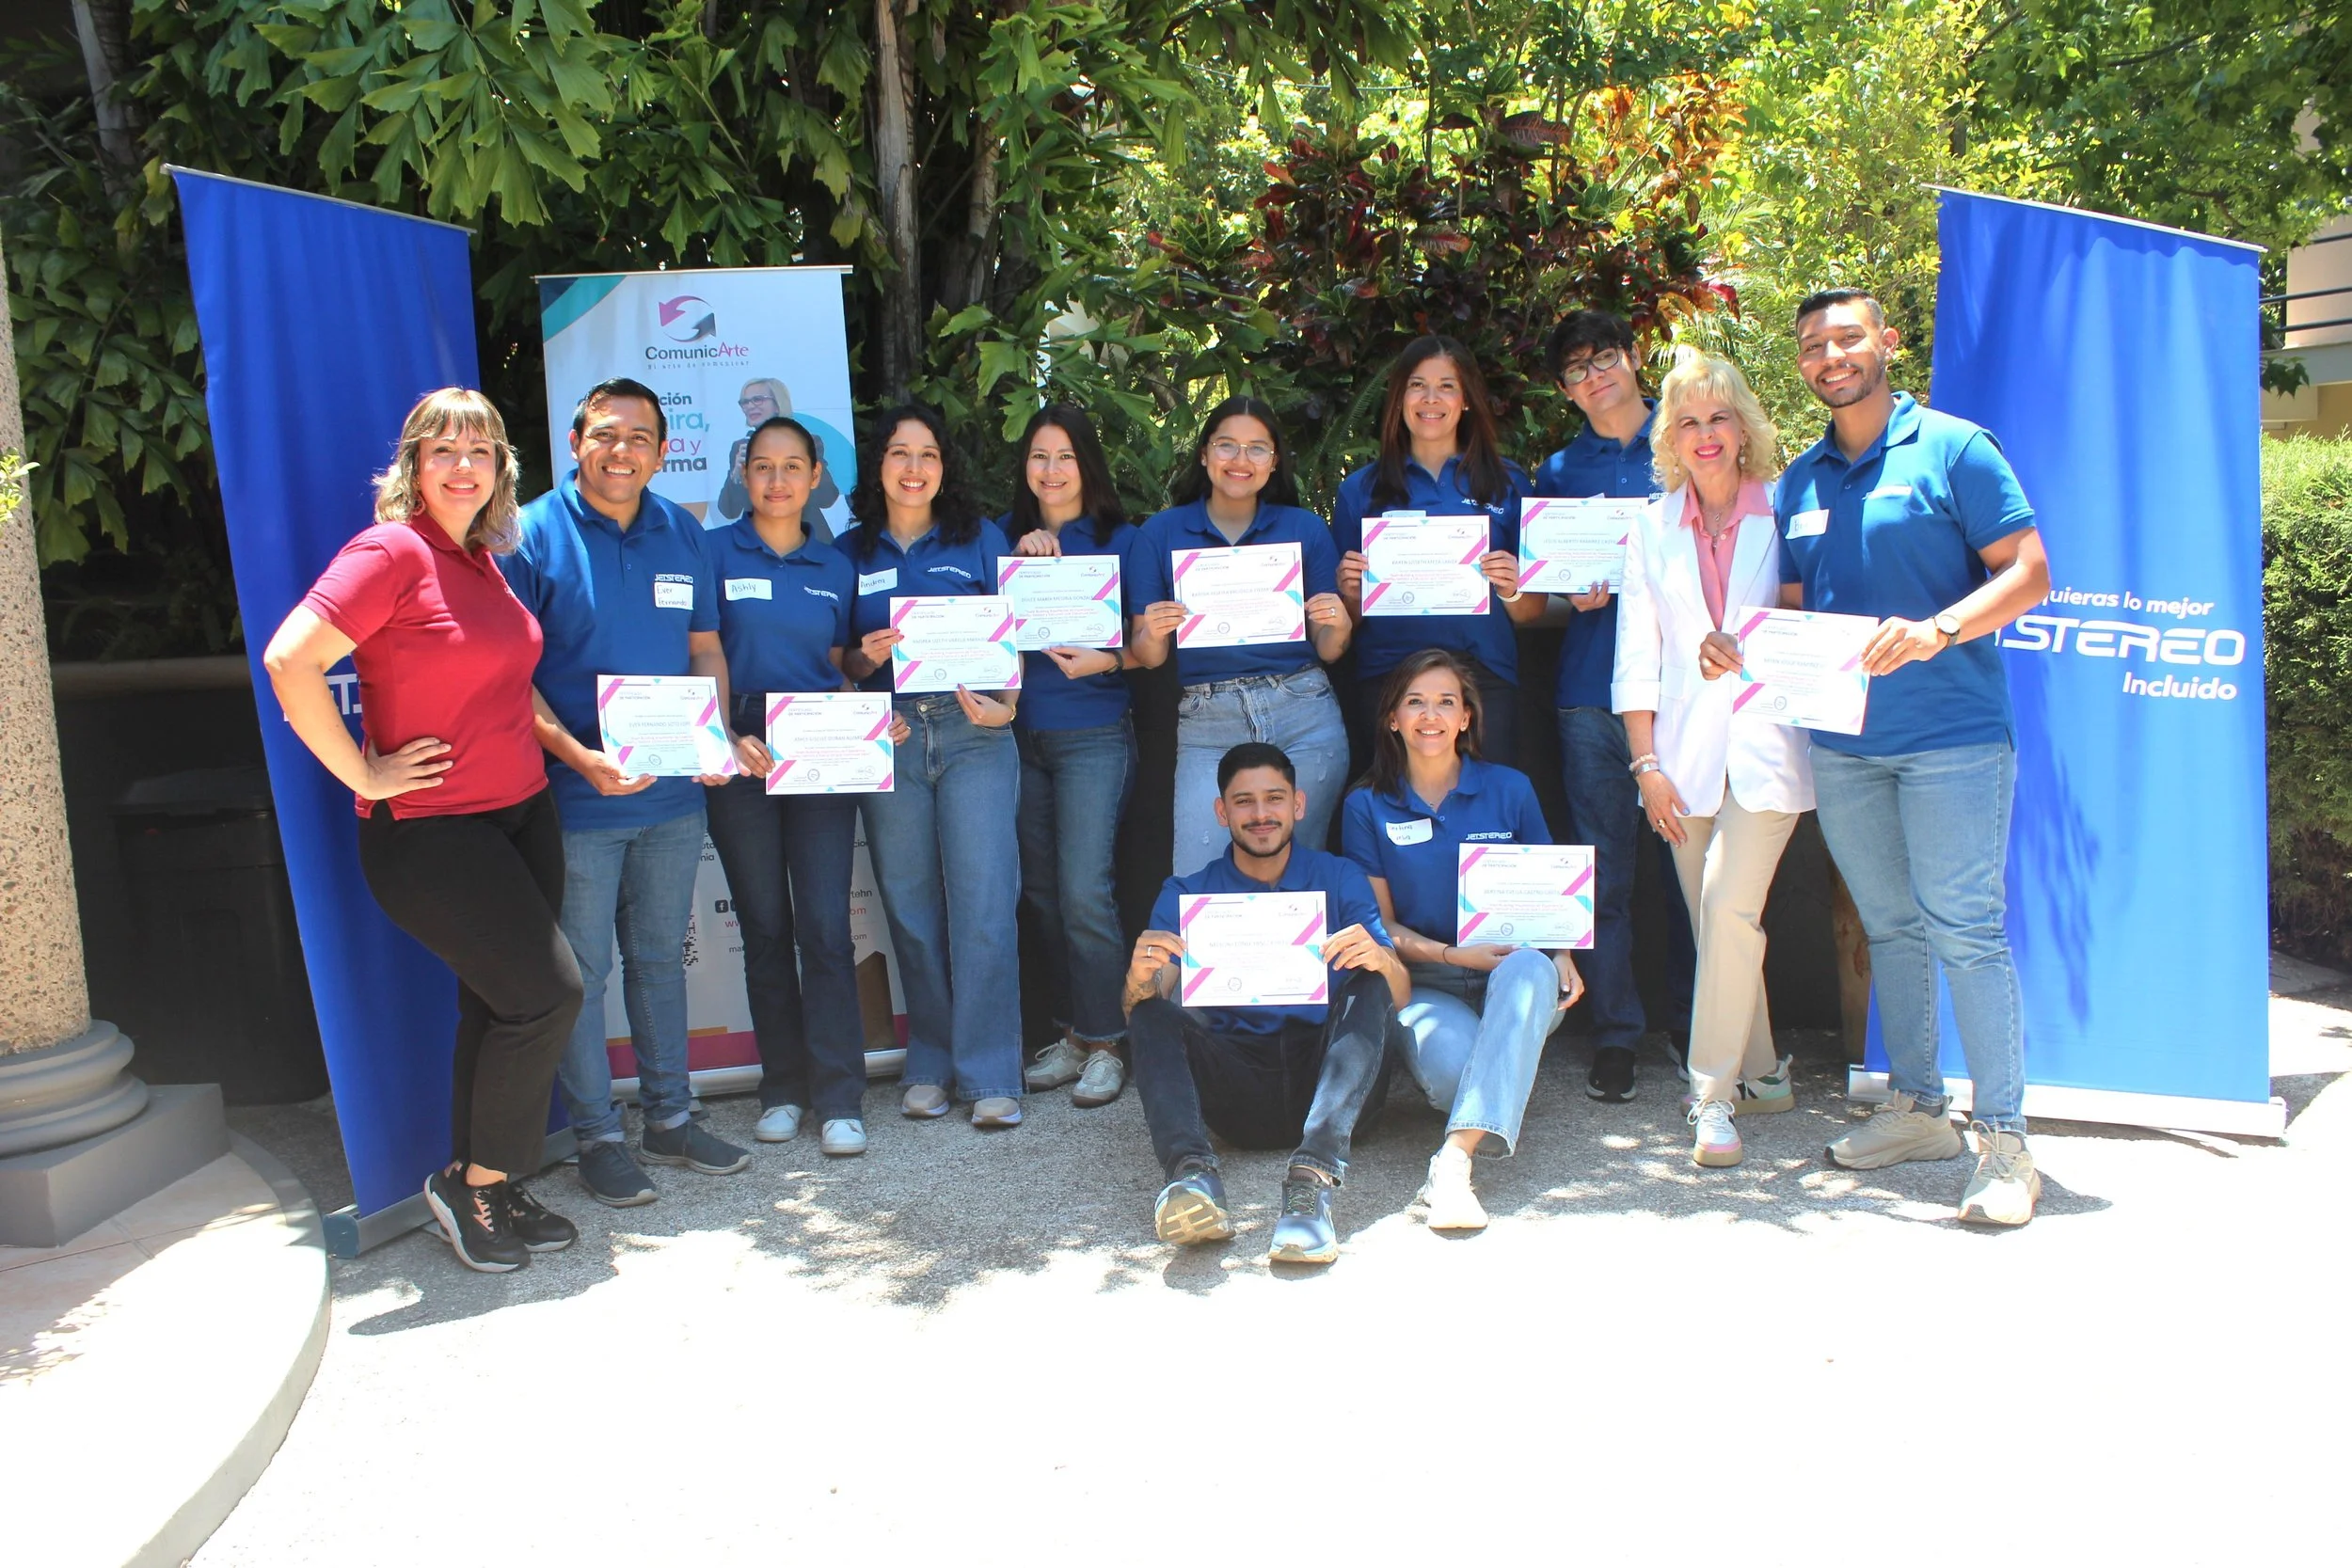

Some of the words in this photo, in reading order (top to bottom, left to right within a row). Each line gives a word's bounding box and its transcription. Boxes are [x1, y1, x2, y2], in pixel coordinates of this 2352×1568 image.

[645, 341, 749, 359] ComunicArte
[659, 392, 692, 405] ción
[668, 408, 710, 433] ira,
[667, 438, 685, 452] a
[690, 440, 702, 455] y
[662, 457, 707, 473] rma
[731, 582, 755, 593] Ashly
[2123, 591, 2142, 611] lo
[2145, 596, 2215, 620] mejor
[2122, 672, 2237, 700] Incluido
[1466, 832, 1512, 841] JETSTEREO
[700, 853, 715, 862] nia
